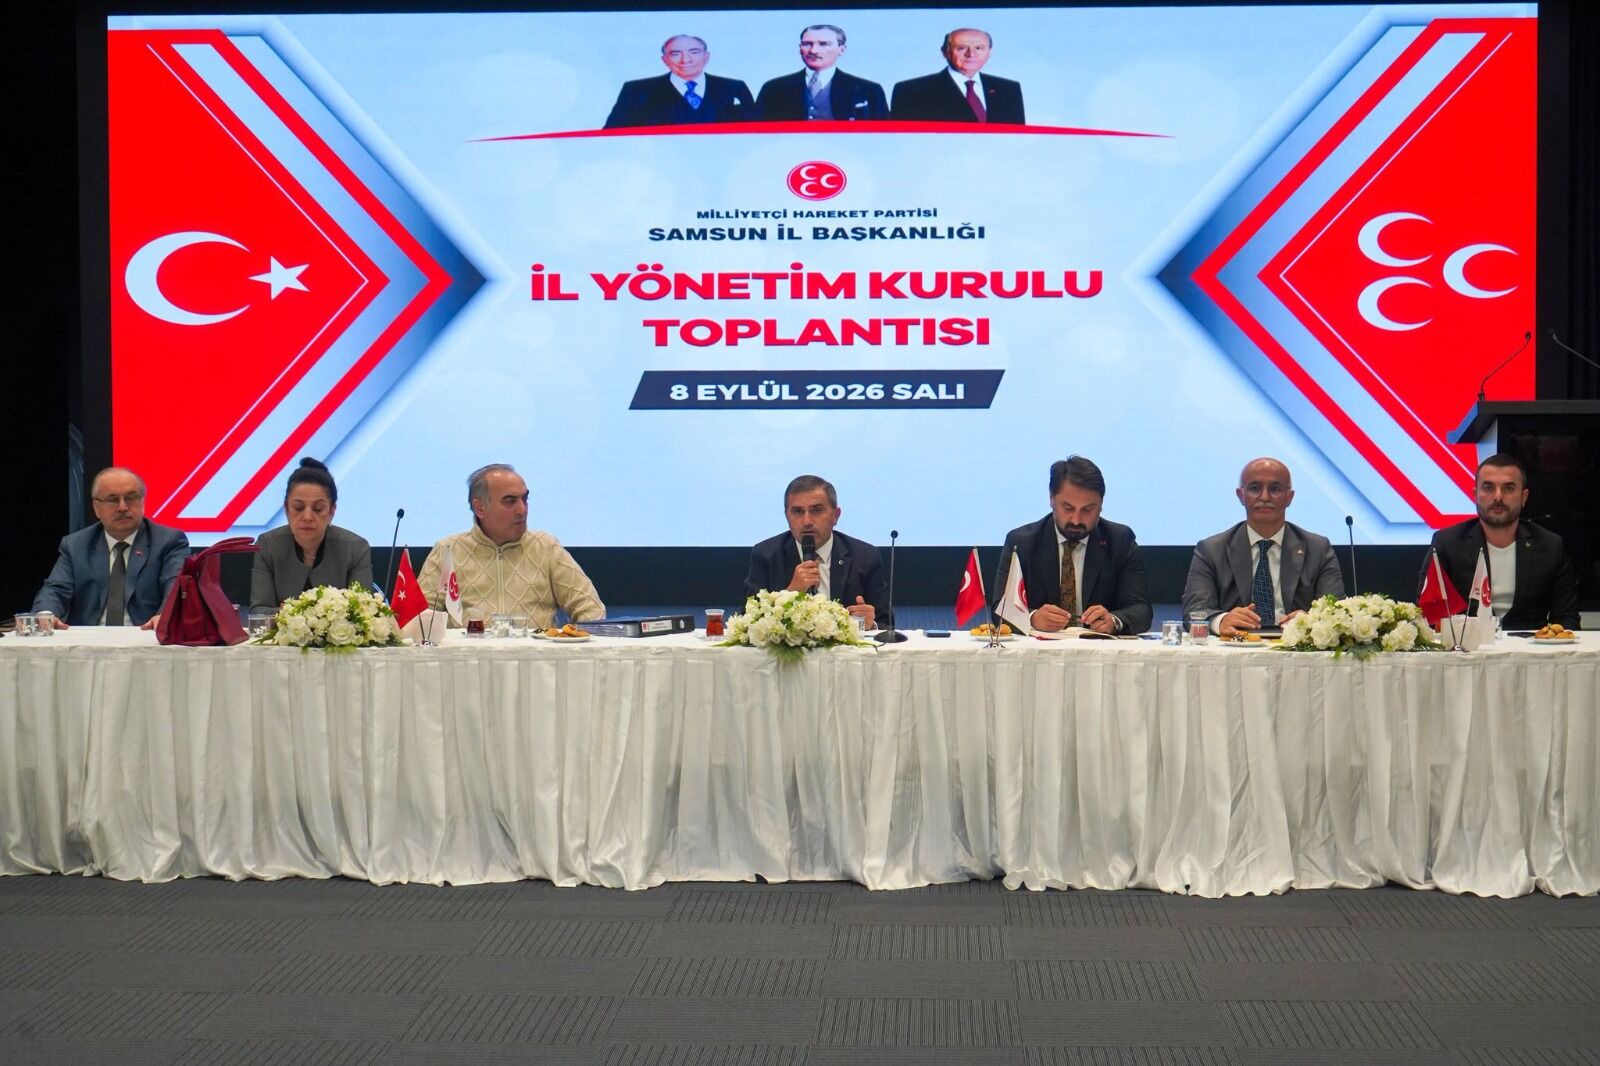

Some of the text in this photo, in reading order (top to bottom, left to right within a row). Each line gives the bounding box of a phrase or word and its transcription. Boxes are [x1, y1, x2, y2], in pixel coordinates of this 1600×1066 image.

[696, 207, 938, 220] MİLLİYETÇİ HAREKET PARTİSİ
[648, 222, 985, 242] SAMSUN İL BAŞKANLIĞI
[531, 262, 1103, 301] İL YÖNETİM KURULU
[643, 317, 990, 347] TOPLANTISI
[669, 380, 965, 401] 8 EYLÜL 2026 SALI
